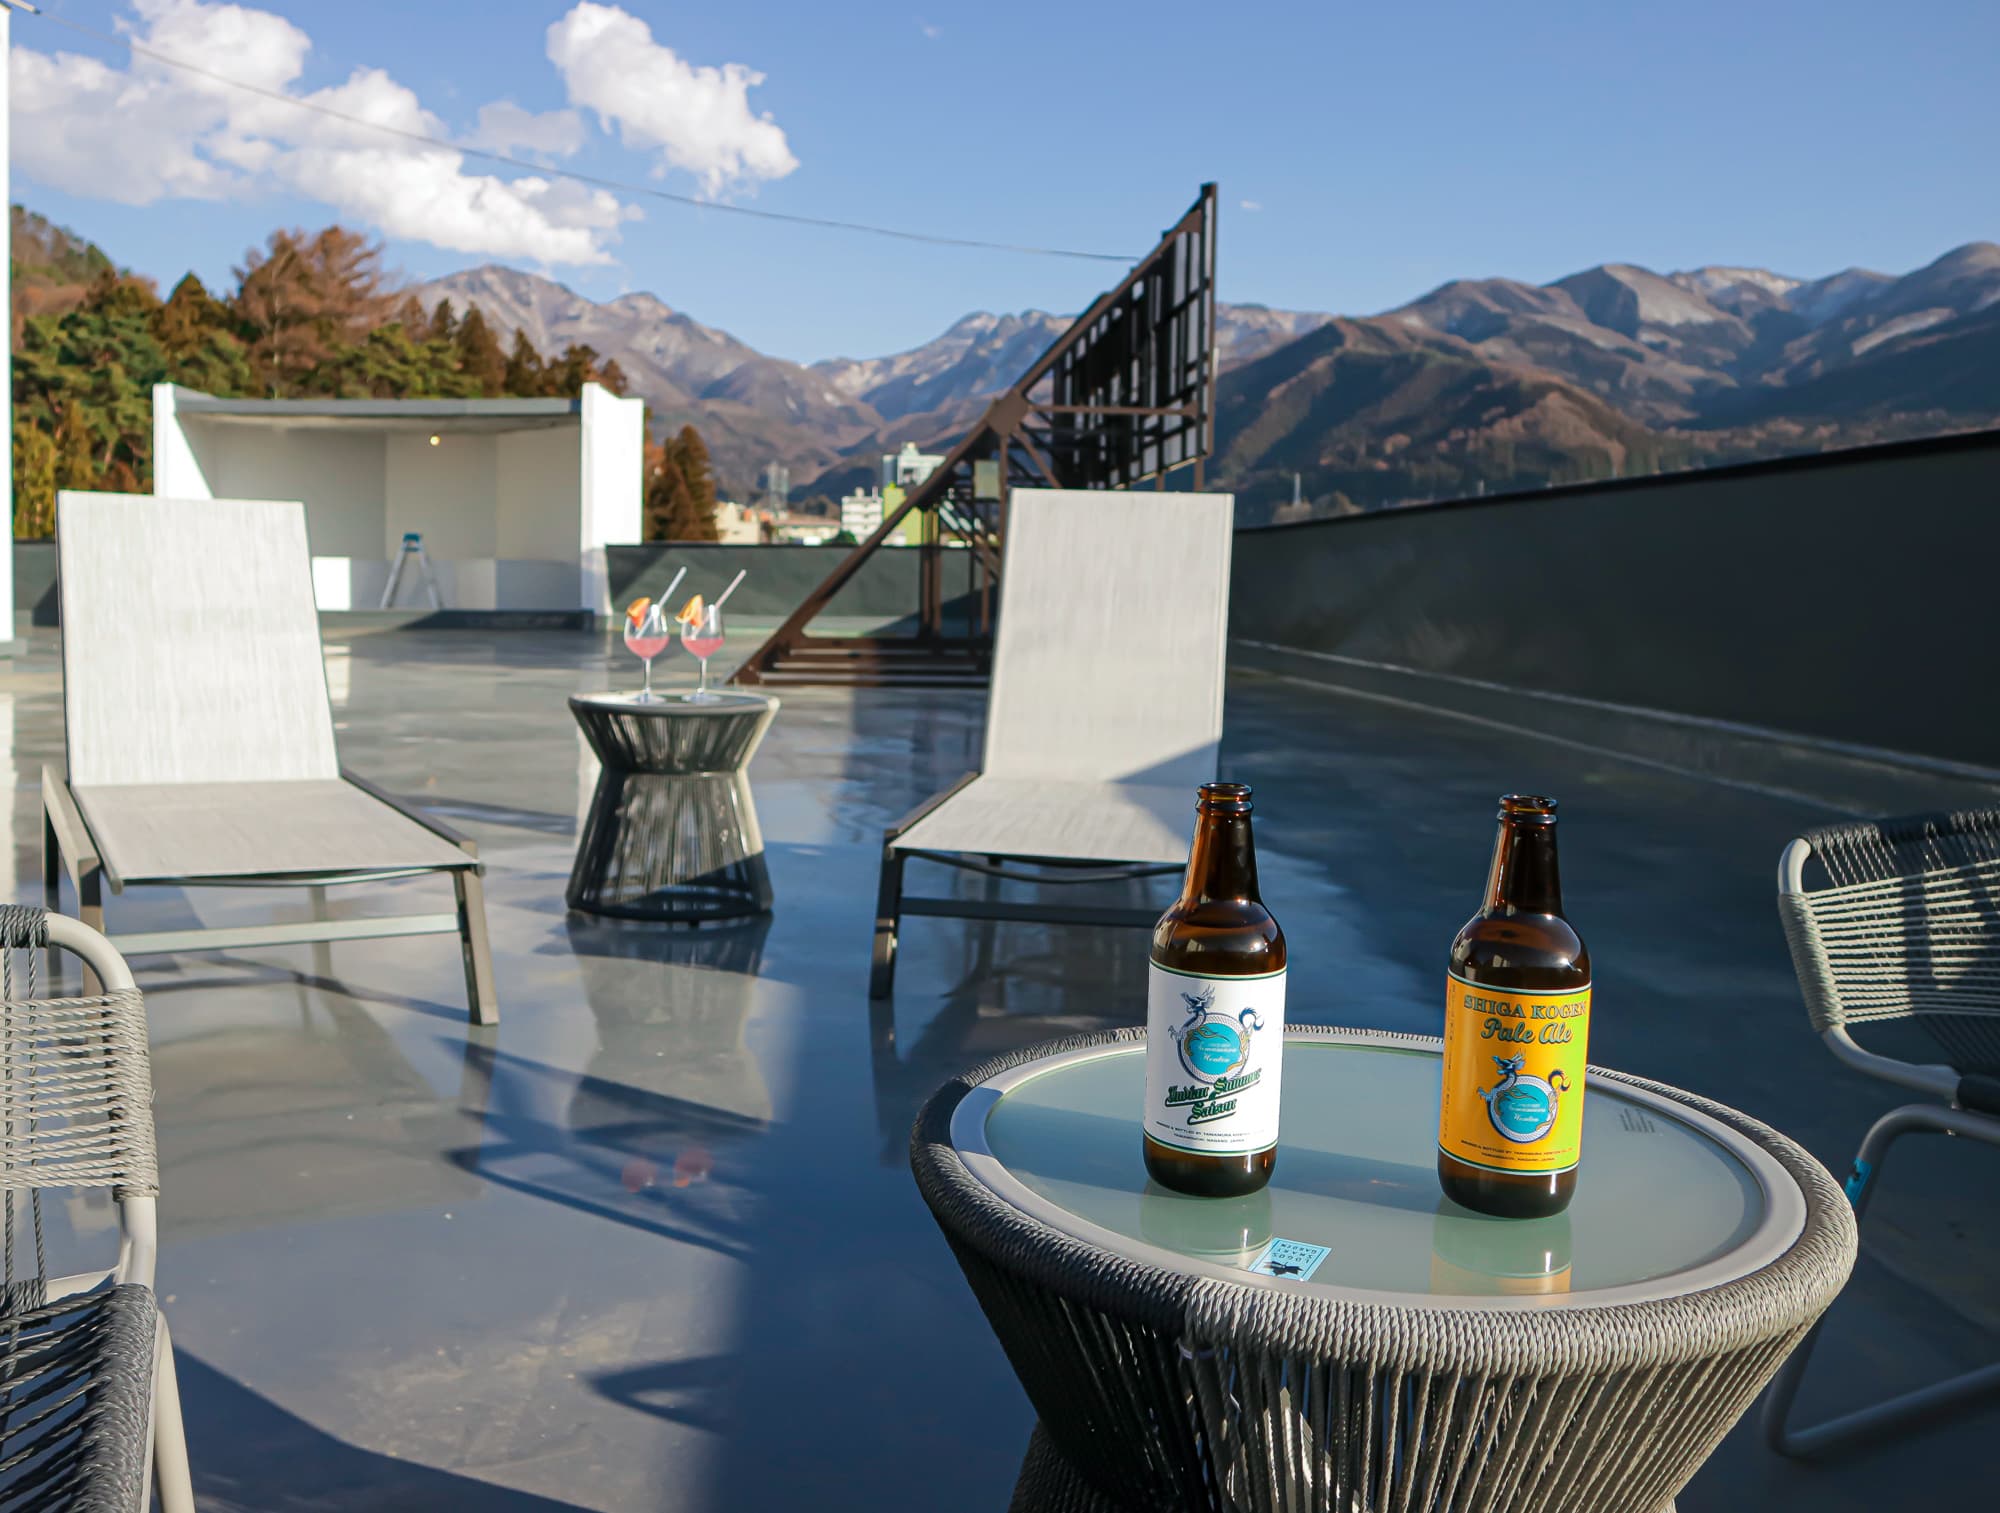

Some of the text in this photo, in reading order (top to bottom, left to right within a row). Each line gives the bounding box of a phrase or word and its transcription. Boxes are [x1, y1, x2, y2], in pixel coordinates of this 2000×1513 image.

[1464, 995, 1587, 1019] SHIGA KOGEN
[1481, 1017, 1573, 1044] Pale Ale
